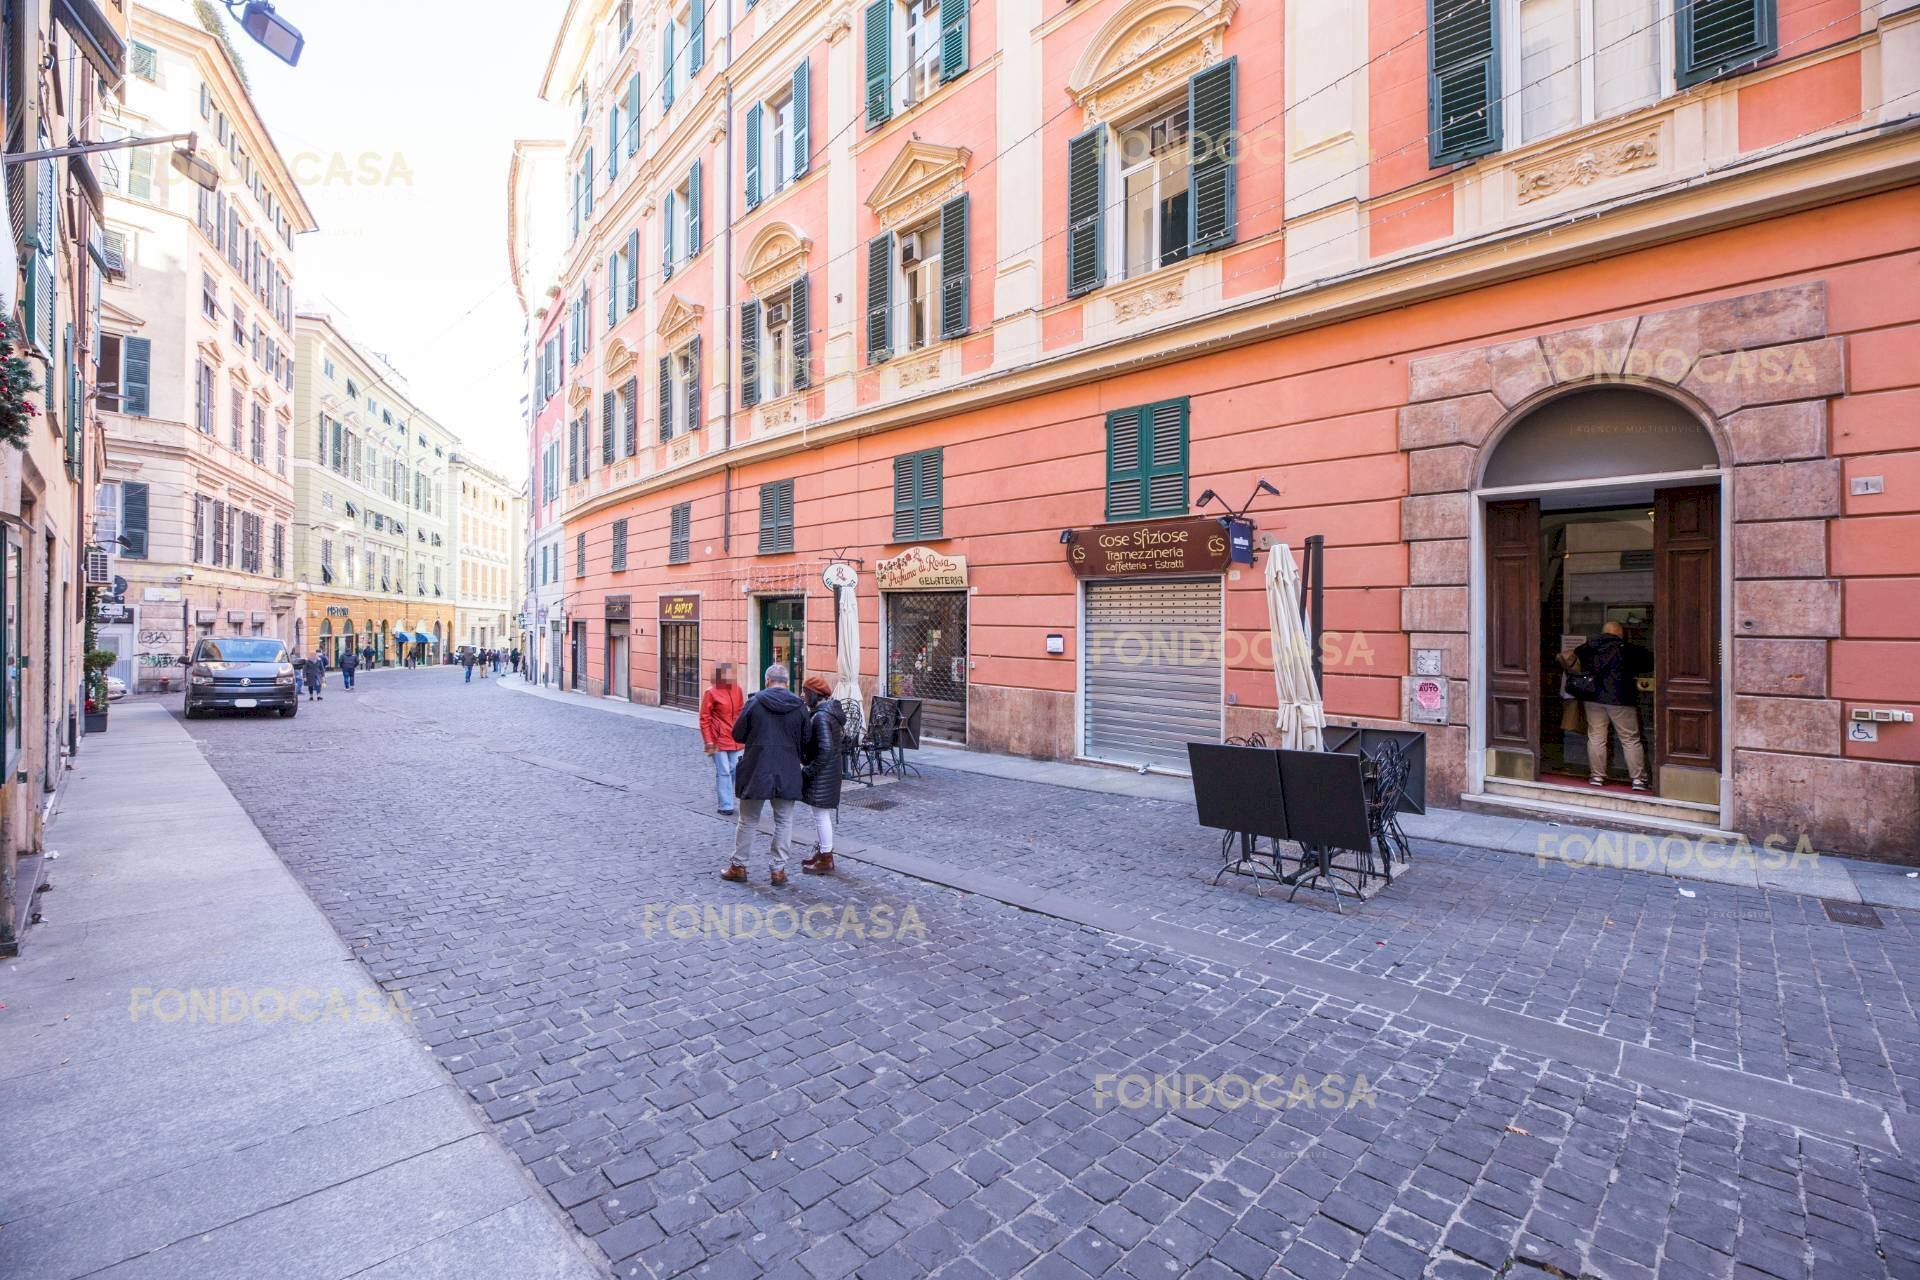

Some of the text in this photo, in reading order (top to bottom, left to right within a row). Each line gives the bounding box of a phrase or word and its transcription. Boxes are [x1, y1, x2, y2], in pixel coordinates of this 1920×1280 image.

[1099, 528, 1189, 549] Cose Sfiziose
[1105, 547, 1184, 561] Tramezzineria
[887, 569, 917, 587] Profumo
[926, 554, 957, 573] Rosa
[1105, 561, 1147, 574] Caffetteria
[1155, 559, 1185, 570] Estratti
[918, 576, 964, 586] GELATERIA
